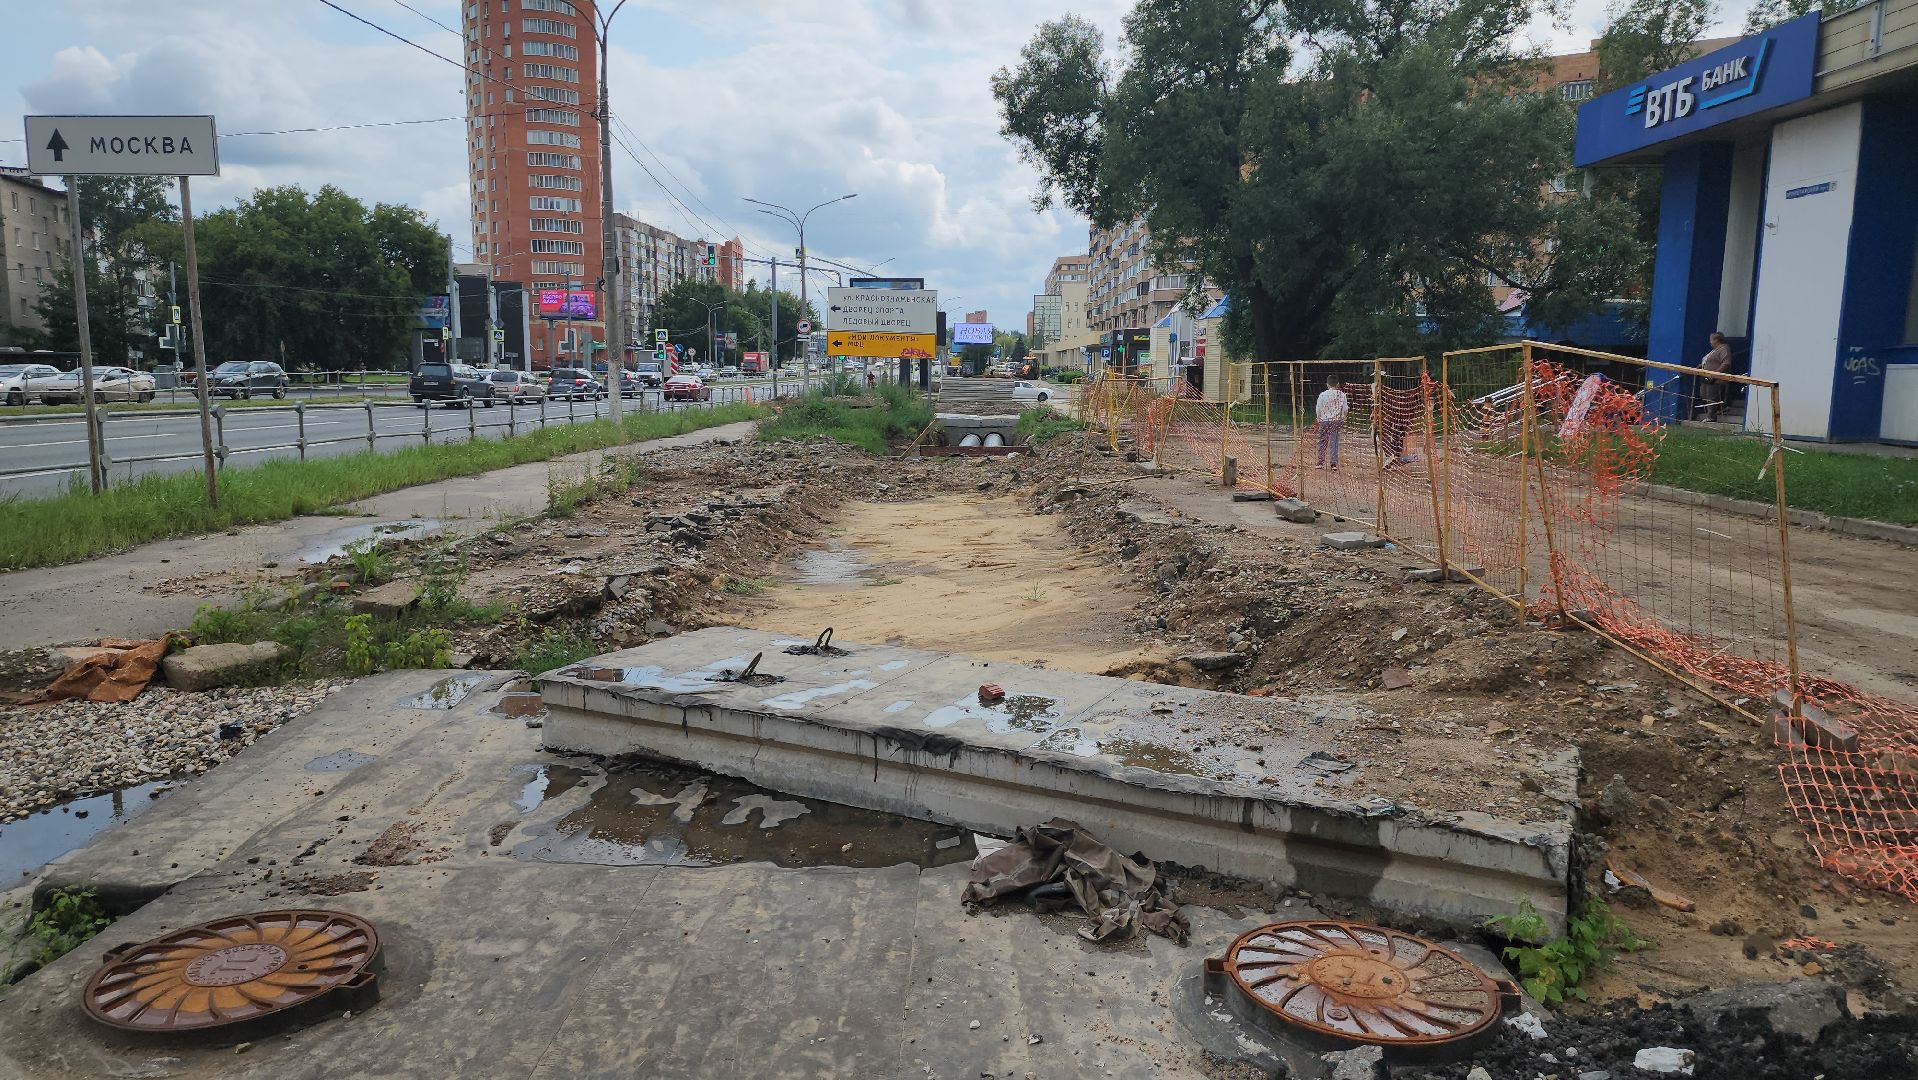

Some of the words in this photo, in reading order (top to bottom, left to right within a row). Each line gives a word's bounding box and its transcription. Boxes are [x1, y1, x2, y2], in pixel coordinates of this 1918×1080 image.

[1644, 75, 1694, 129] ВТБ
[1701, 55, 1747, 91] БАНК
[90, 136, 194, 154] МОСКВА
[842, 306, 873, 314] ДВОРЕЦ
[842, 317, 879, 326] ЛЕДОВЫЙ
